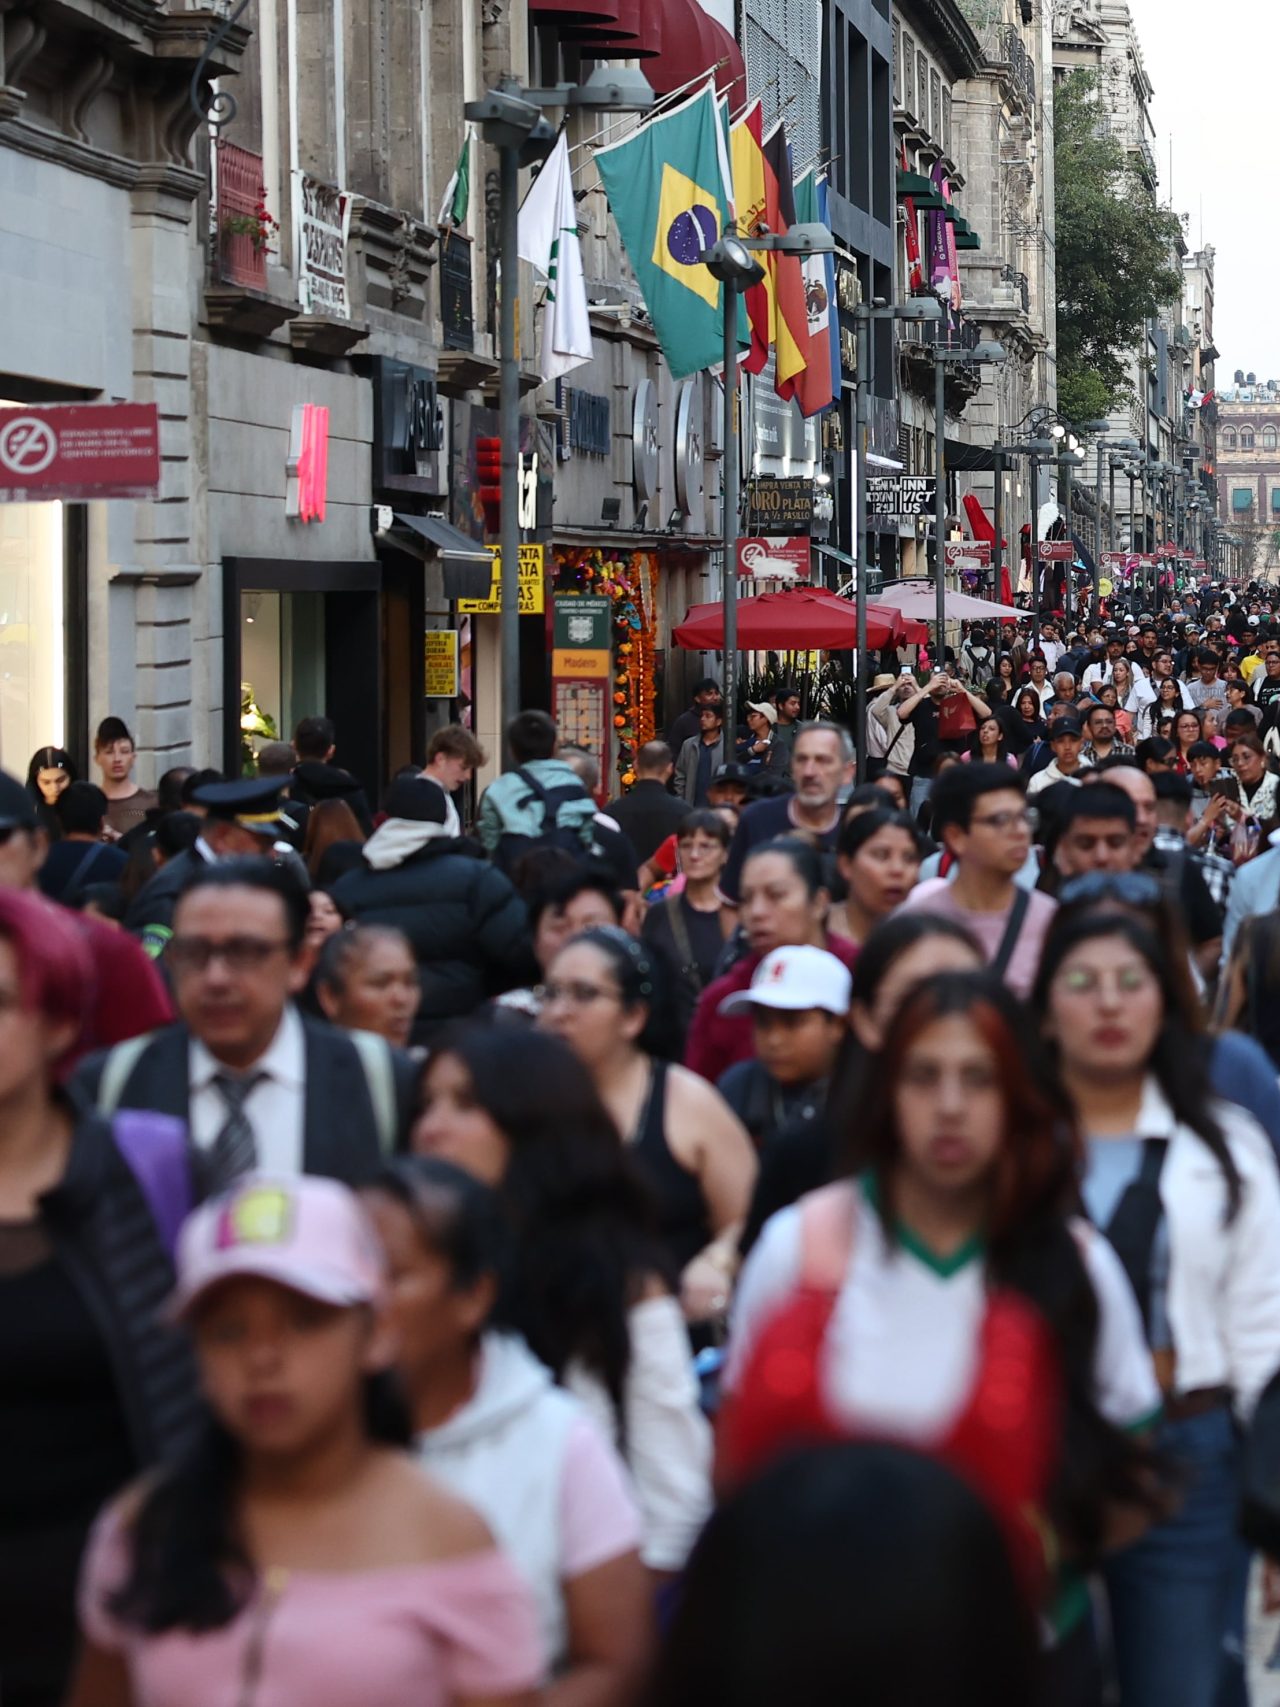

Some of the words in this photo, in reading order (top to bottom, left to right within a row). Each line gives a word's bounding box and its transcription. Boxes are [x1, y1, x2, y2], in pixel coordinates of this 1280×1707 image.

[903, 480, 926, 491] INN
[751, 490, 780, 510] ORO
[782, 498, 811, 510] PLATA
[903, 491, 933, 502] VICT
[903, 503, 921, 514] US
[783, 511, 811, 520] PASILLO
[478, 602, 535, 610] COMPRAS
[564, 657, 597, 668] Madero
